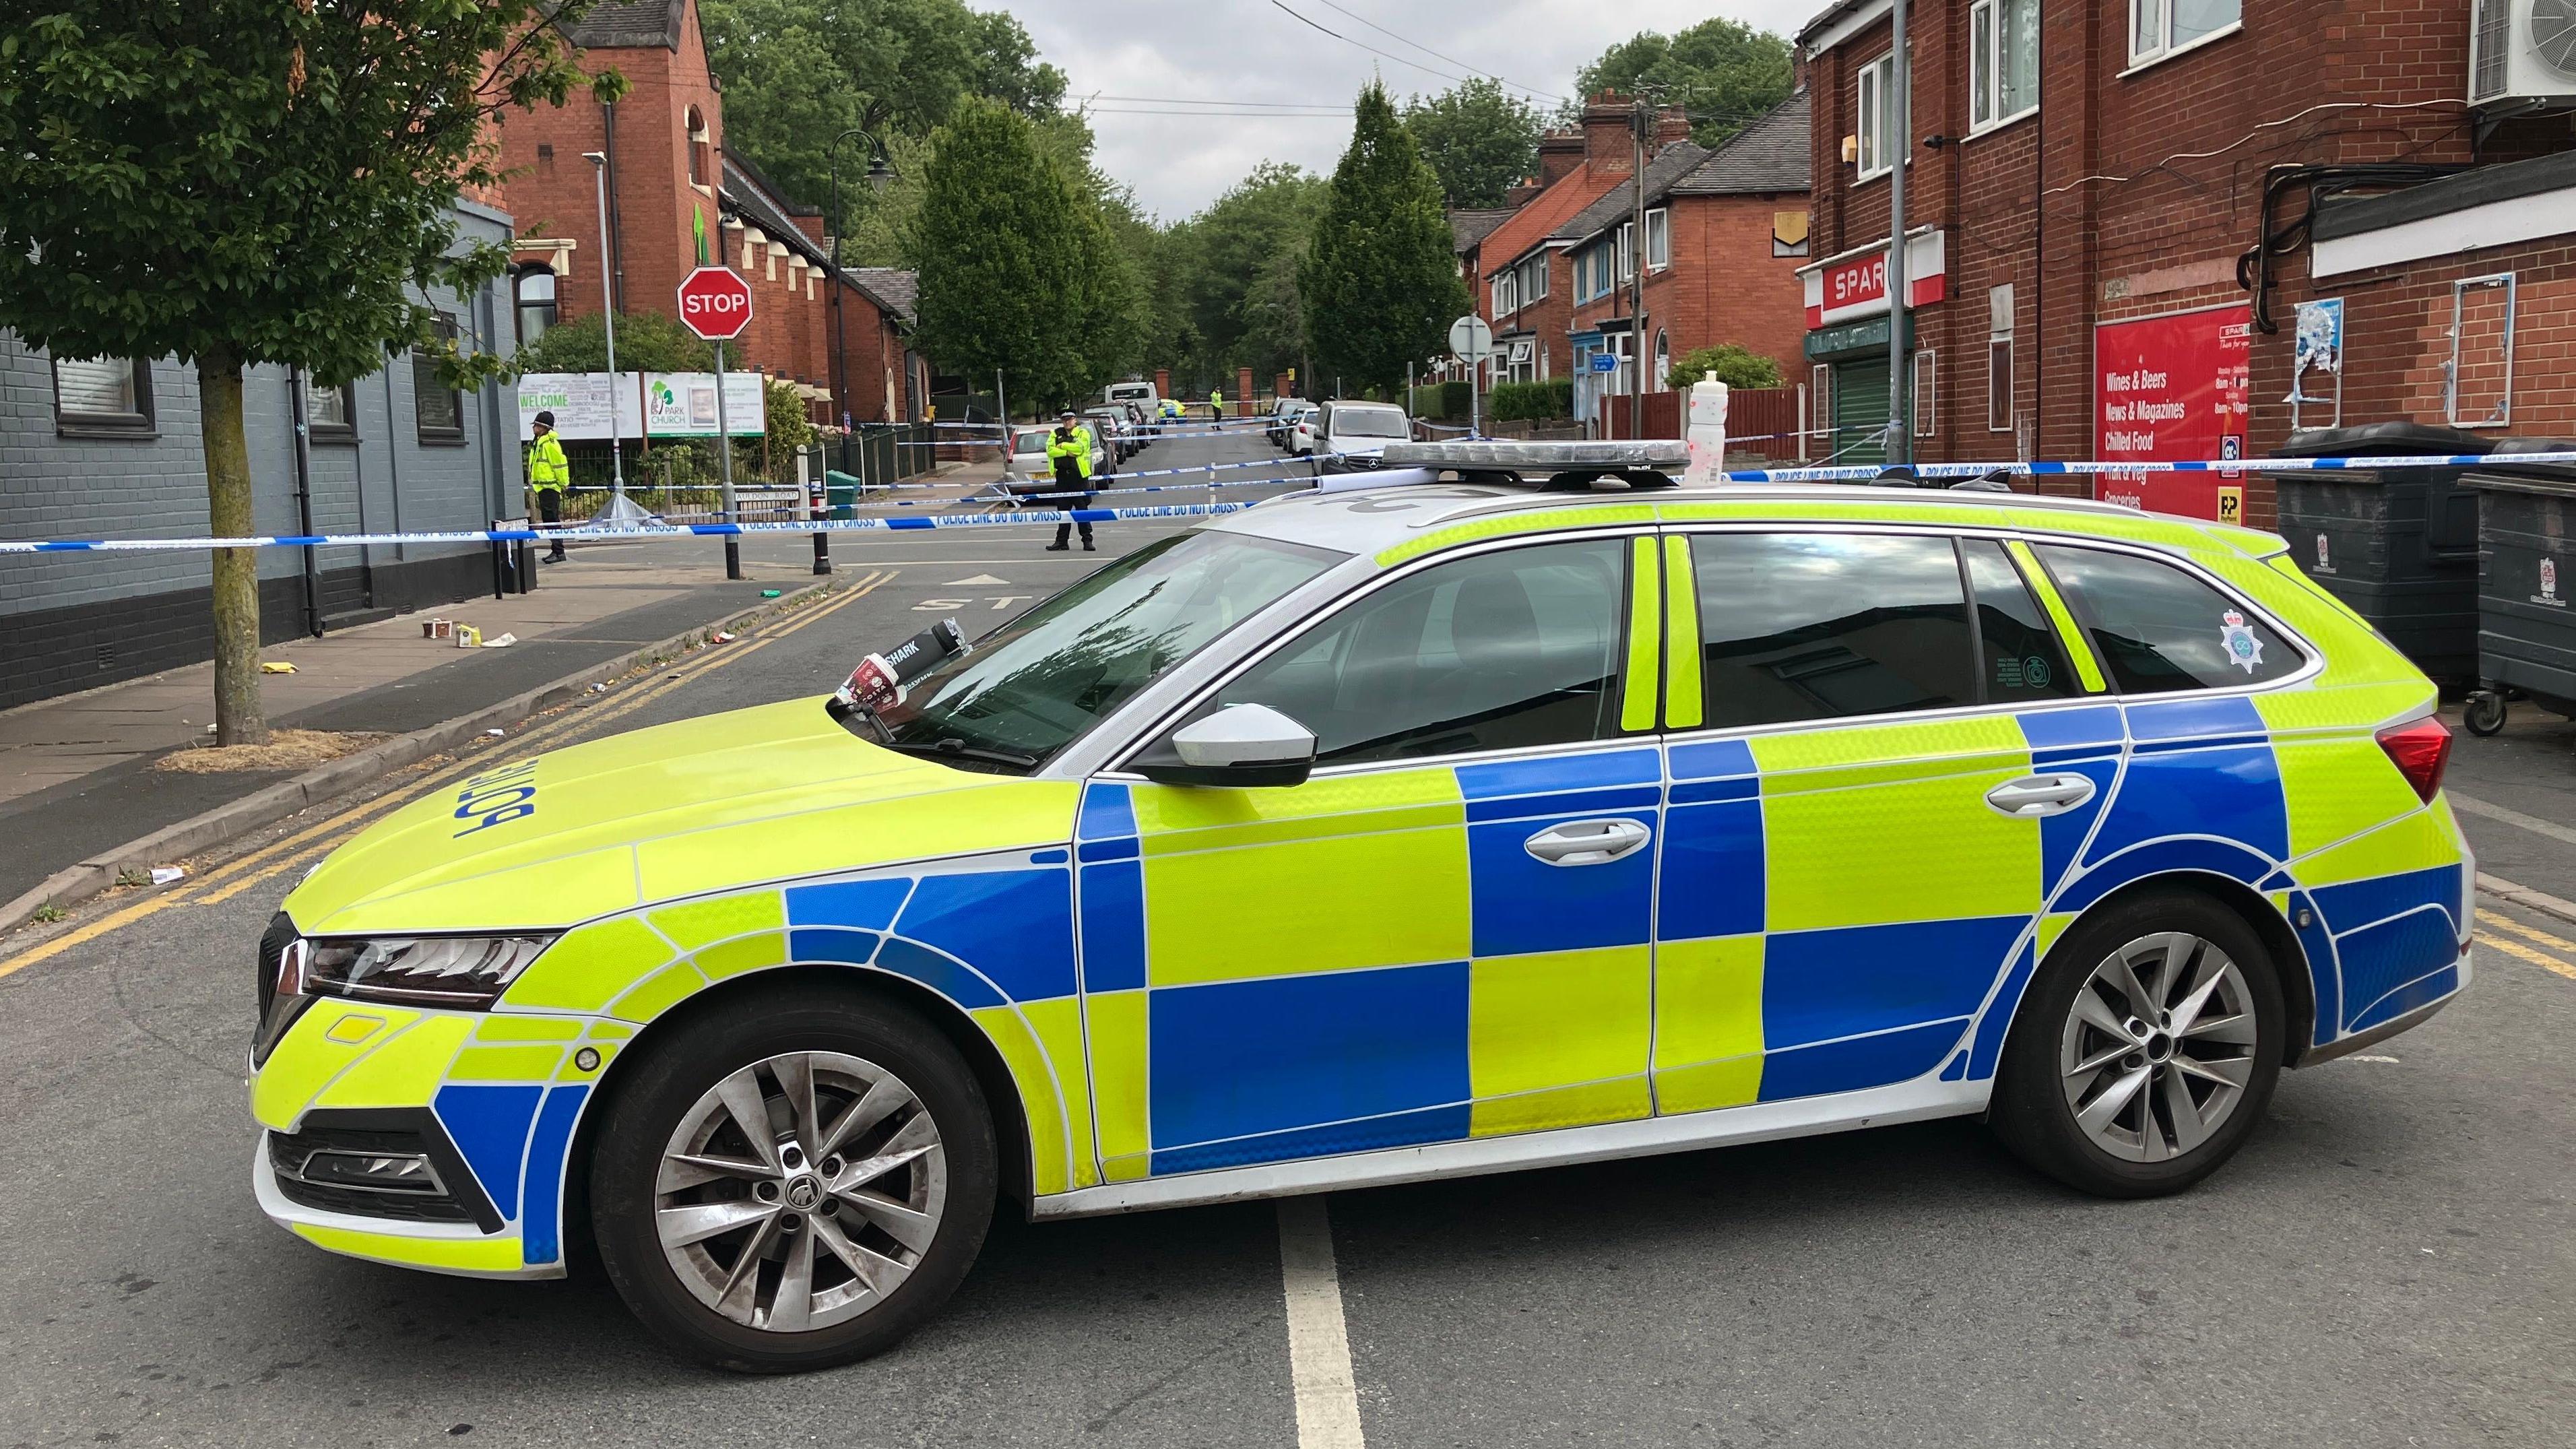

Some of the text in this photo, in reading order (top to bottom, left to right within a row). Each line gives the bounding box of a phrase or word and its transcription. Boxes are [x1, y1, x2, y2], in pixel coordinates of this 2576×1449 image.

[1835, 261, 1883, 300] SPAR
[686, 294, 746, 314] STOP
[2224, 326, 2244, 335] SPAR
[2106, 369, 2167, 392] Wines & Beers
[2216, 377, 2228, 389] 8am
[519, 394, 569, 408] WELCOME
[2214, 402, 2228, 414] 8am
[2105, 398, 2185, 425] News & Magazines
[651, 416, 686, 424] CHURCH
[2105, 430, 2154, 451] Chilled Food
[1120, 503, 1238, 518] POLICE LINE DO NOT CROSS
[2221, 496, 2238, 515] PP
[743, 521, 777, 530] POLICE
[780, 521, 801, 529] LINE
[804, 521, 818, 529] DO
[821, 519, 840, 528] NOT
[937, 511, 1062, 525] POLICE LINE DO NOT CROSS
[911, 596, 1045, 610] ST
[884, 640, 920, 668] SHARK
